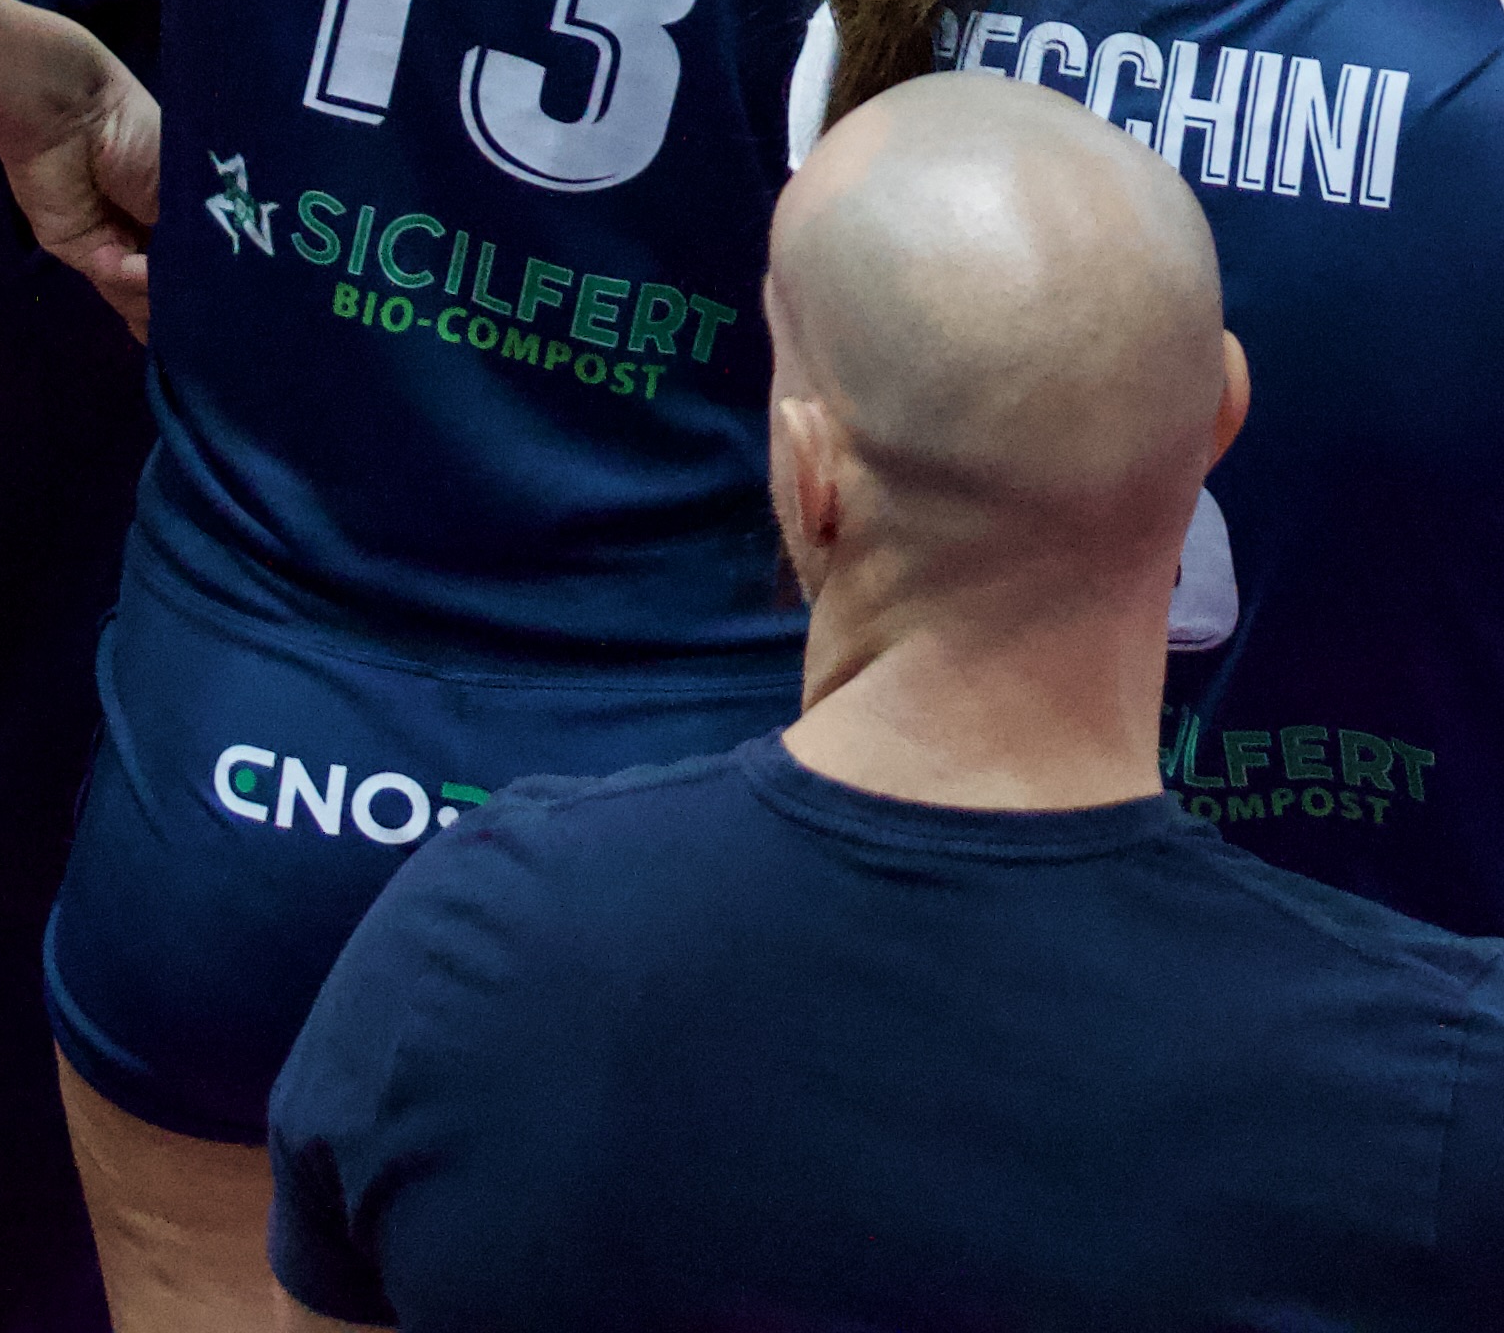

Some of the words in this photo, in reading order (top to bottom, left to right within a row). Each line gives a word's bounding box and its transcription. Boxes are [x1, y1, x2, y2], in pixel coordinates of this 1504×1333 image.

[291, 189, 738, 363] SICILFERT
[332, 281, 667, 400] BIO-COMPOST
[1159, 703, 1436, 802] ILFERT
[1177, 786, 1392, 825] OMPOST
